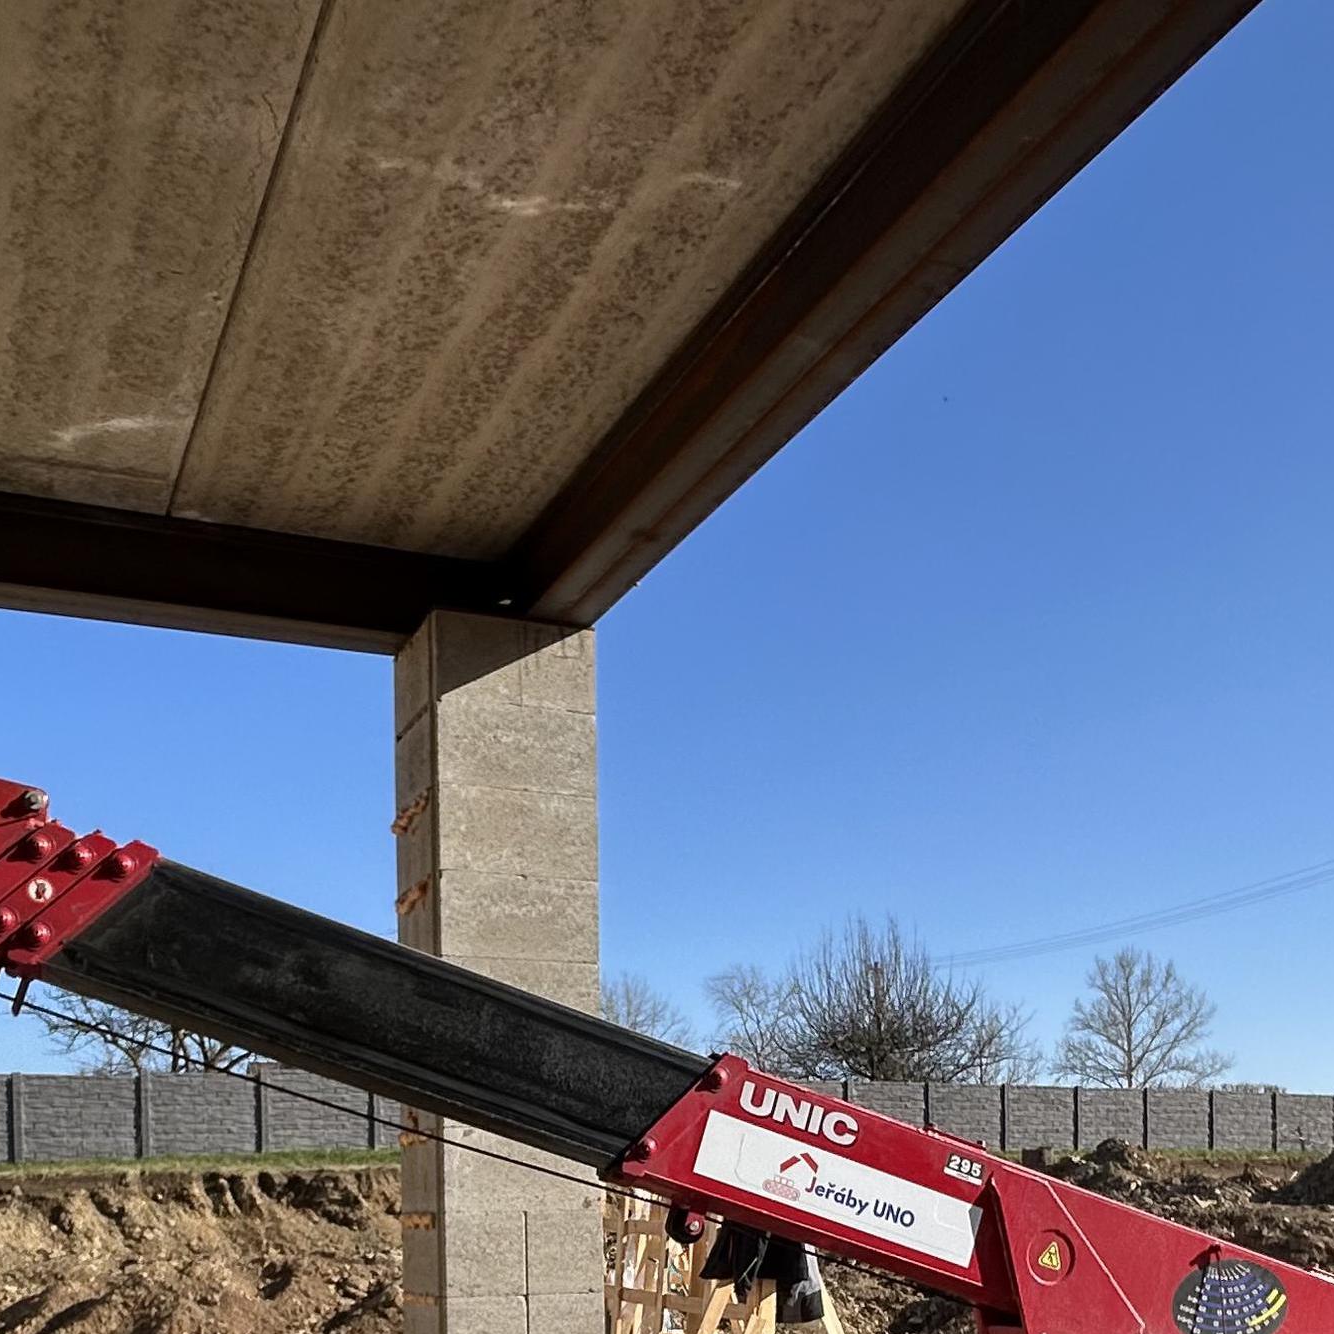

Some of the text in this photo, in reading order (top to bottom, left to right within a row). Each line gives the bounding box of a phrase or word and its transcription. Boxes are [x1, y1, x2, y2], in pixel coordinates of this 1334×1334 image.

[739, 1080, 859, 1146] UNIC
[948, 1154, 982, 1177] 295
[805, 1176, 915, 1228] Jeřáby UNO
